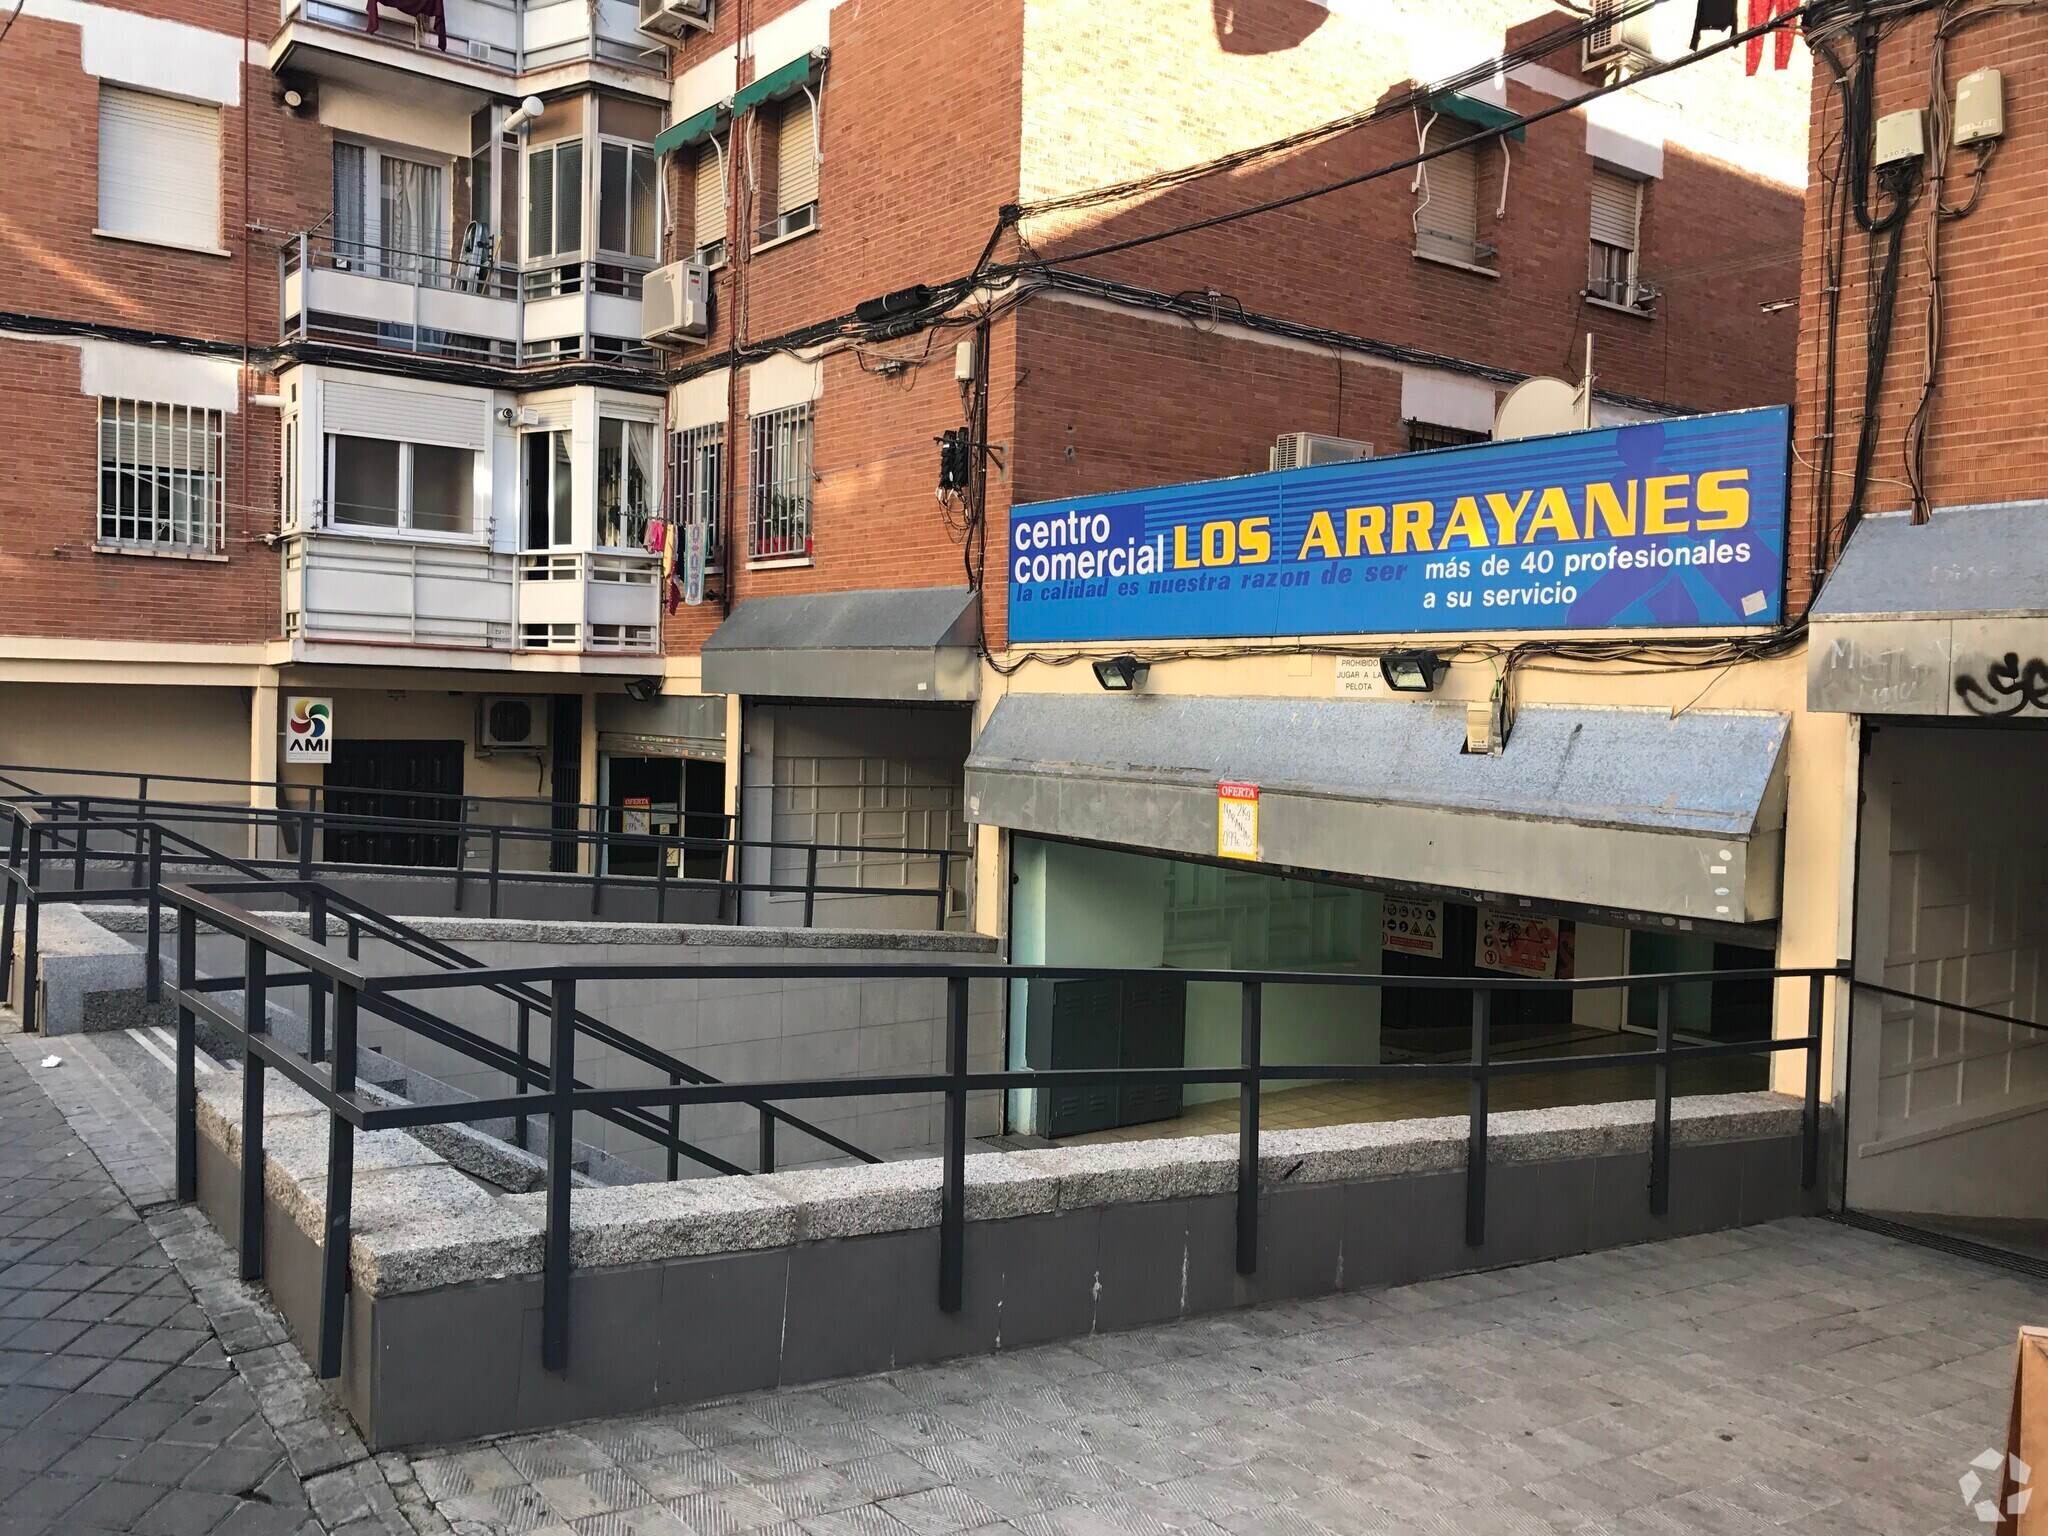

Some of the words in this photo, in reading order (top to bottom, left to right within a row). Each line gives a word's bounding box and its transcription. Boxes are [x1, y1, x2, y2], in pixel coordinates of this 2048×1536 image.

[1173, 516, 1271, 570] LOS
[1297, 468, 1750, 561] ARRAYANES
[1015, 511, 1110, 551] centro
[1014, 534, 1164, 584] comercial
[1425, 556, 1471, 580] más
[1481, 554, 1510, 577] de
[1520, 550, 1554, 574] 40
[1564, 539, 1751, 577] profesionales
[1016, 582, 1033, 602] la
[1040, 577, 1110, 600] calidad
[1118, 581, 1140, 596] es
[1149, 572, 1231, 594] nuestra
[1241, 569, 1311, 589] razon
[1321, 561, 1352, 585] de
[1364, 564, 1409, 582] ser
[1423, 592, 1436, 609] a
[1446, 591, 1472, 608] su
[1482, 581, 1577, 607] servicio
[1341, 659, 1378, 667] PROHIBIDO
[1337, 671, 1360, 679] JUGAR
[1363, 671, 1369, 679] A
[1373, 671, 1382, 679] LA
[1345, 682, 1372, 691] PELOTA
[289, 738, 329, 752] AMI
[624, 797, 650, 806] OFERTA
[1221, 785, 1255, 798] OFERTA
